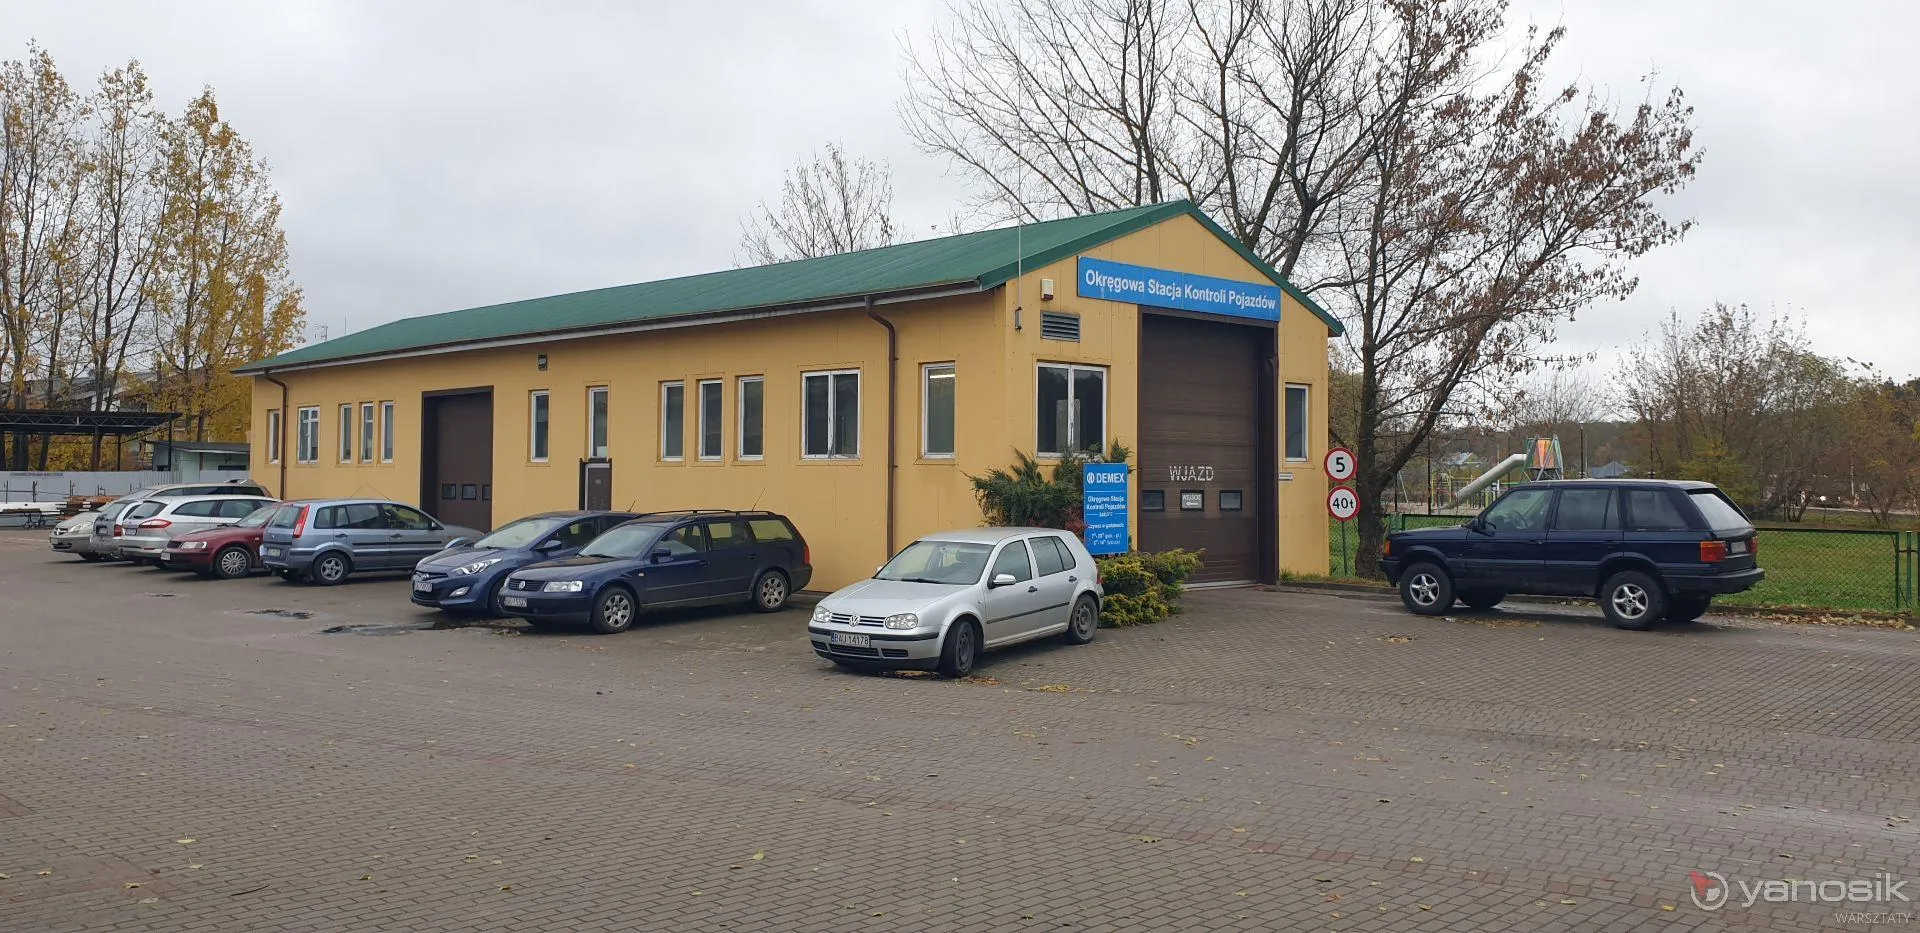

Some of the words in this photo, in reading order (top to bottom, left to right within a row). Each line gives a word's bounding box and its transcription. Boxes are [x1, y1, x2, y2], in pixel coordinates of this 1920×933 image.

[1085, 269, 1145, 293] Okręgowa
[1147, 279, 1182, 301] Stacja
[1184, 284, 1226, 304] Kontroli
[1228, 290, 1276, 310] Pojazdów
[1168, 464, 1214, 482] WJAZD
[1335, 456, 1346, 473] 5
[1096, 472, 1125, 484] DEMEX
[1332, 497, 1354, 509] 40t
